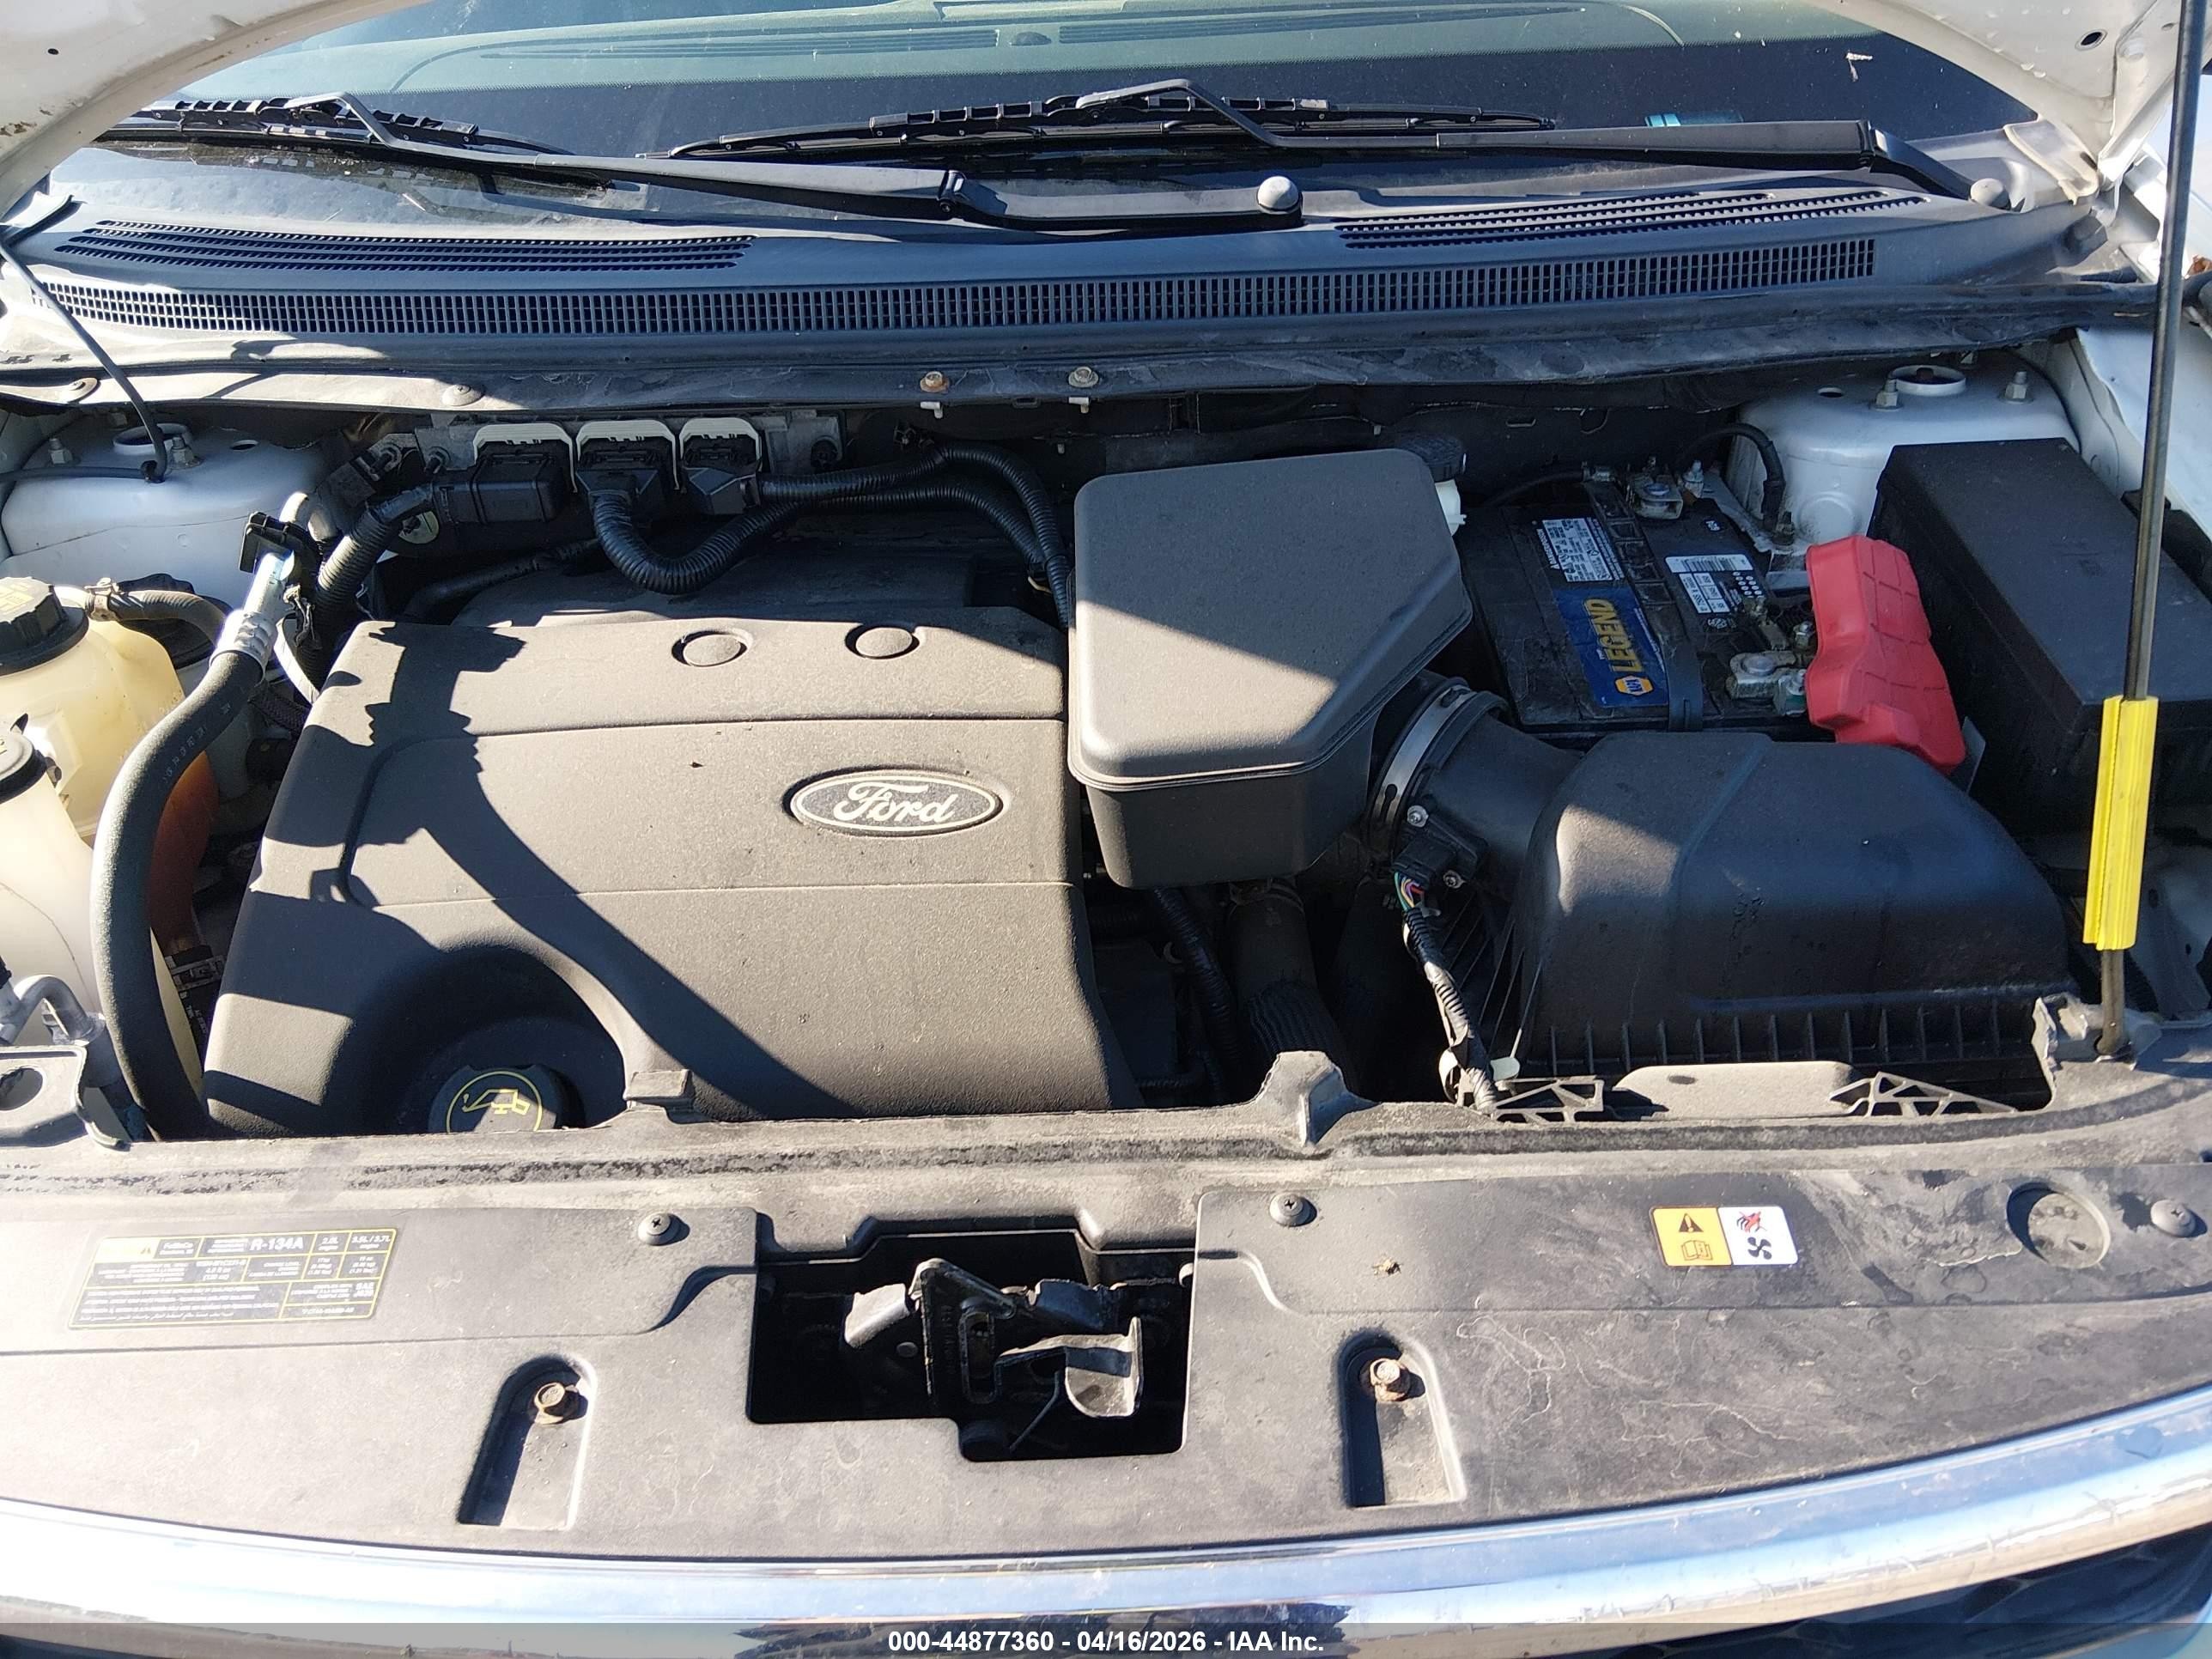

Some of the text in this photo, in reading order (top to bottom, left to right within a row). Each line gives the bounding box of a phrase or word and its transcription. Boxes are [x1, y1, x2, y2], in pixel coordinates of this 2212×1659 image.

[1584, 599, 1643, 672] LEGEND
[833, 781, 959, 823] Ford
[249, 1237, 304, 1251] R-134A
